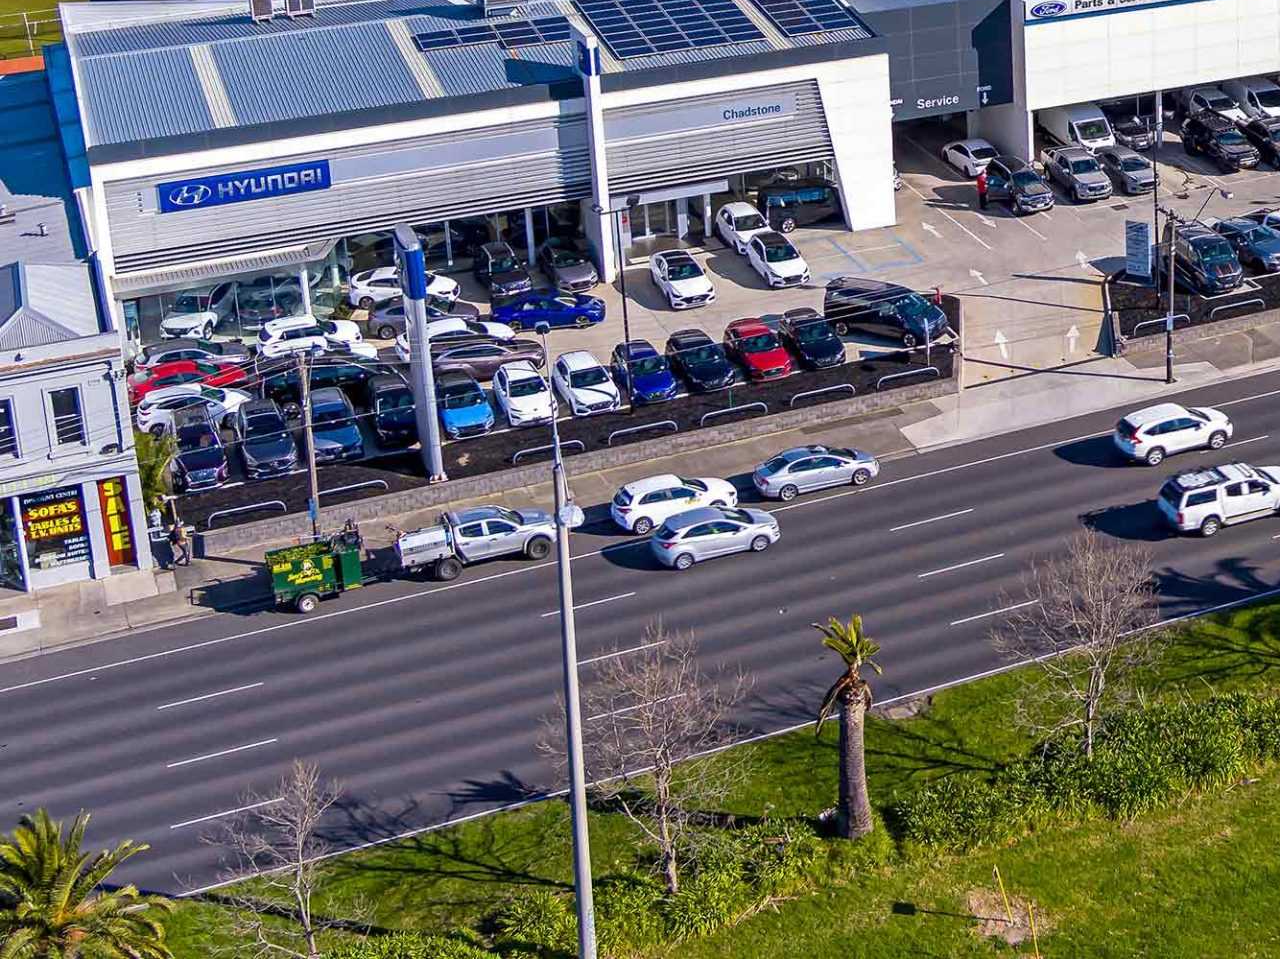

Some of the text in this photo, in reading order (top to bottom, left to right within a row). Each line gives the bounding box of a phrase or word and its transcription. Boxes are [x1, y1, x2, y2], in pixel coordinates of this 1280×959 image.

[723, 105, 781, 120] Chadstone
[917, 95, 960, 109] Service
[218, 168, 321, 200] HYUNDAI
[103, 478, 131, 551] SALE
